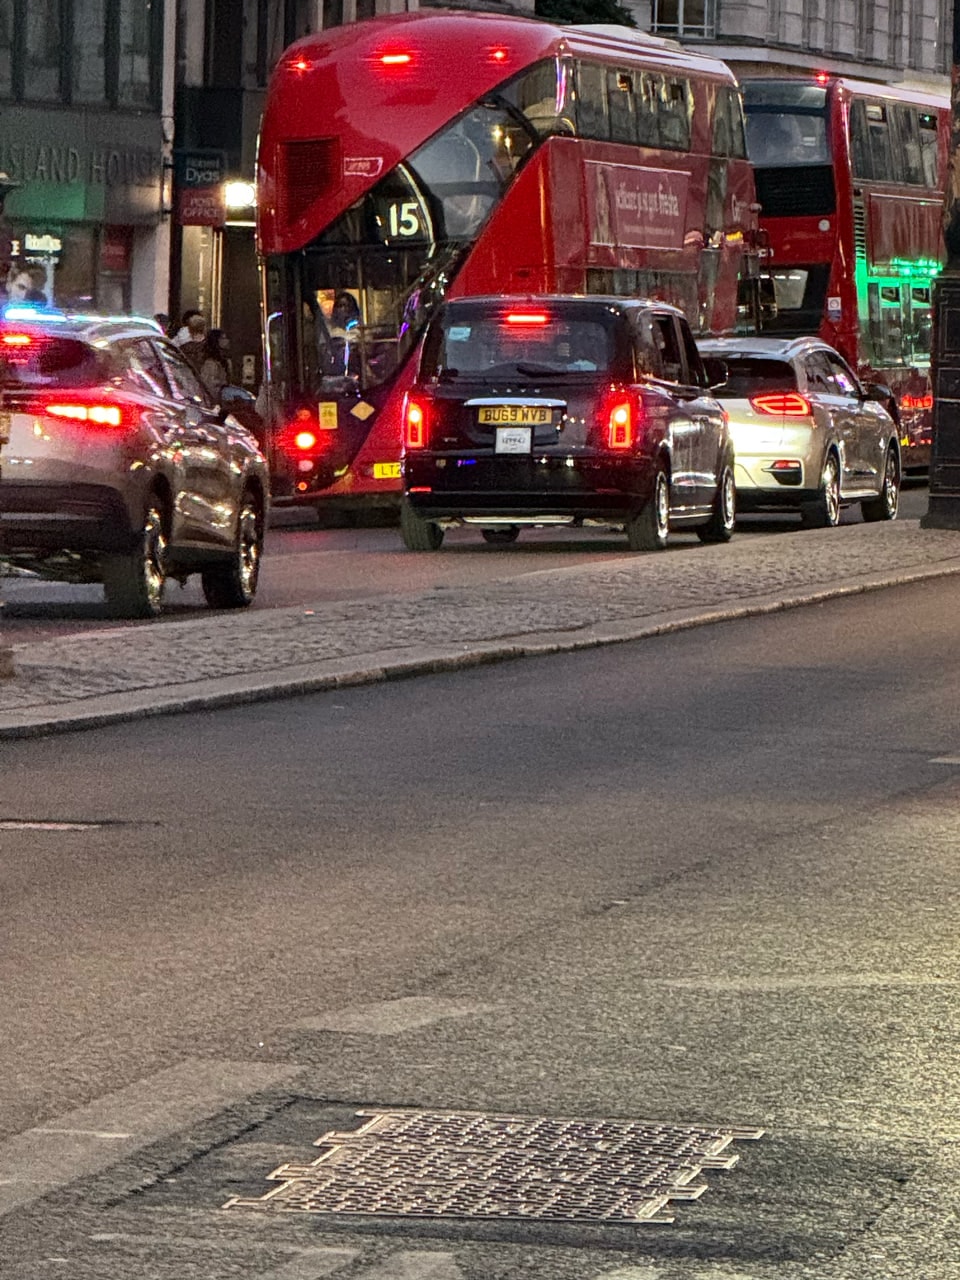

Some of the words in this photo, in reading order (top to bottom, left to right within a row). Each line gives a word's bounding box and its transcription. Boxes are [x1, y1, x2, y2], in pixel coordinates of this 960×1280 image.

[186, 168, 220, 183] Dyas
[389, 203, 419, 236] 15
[484, 409, 518, 421] BU69
